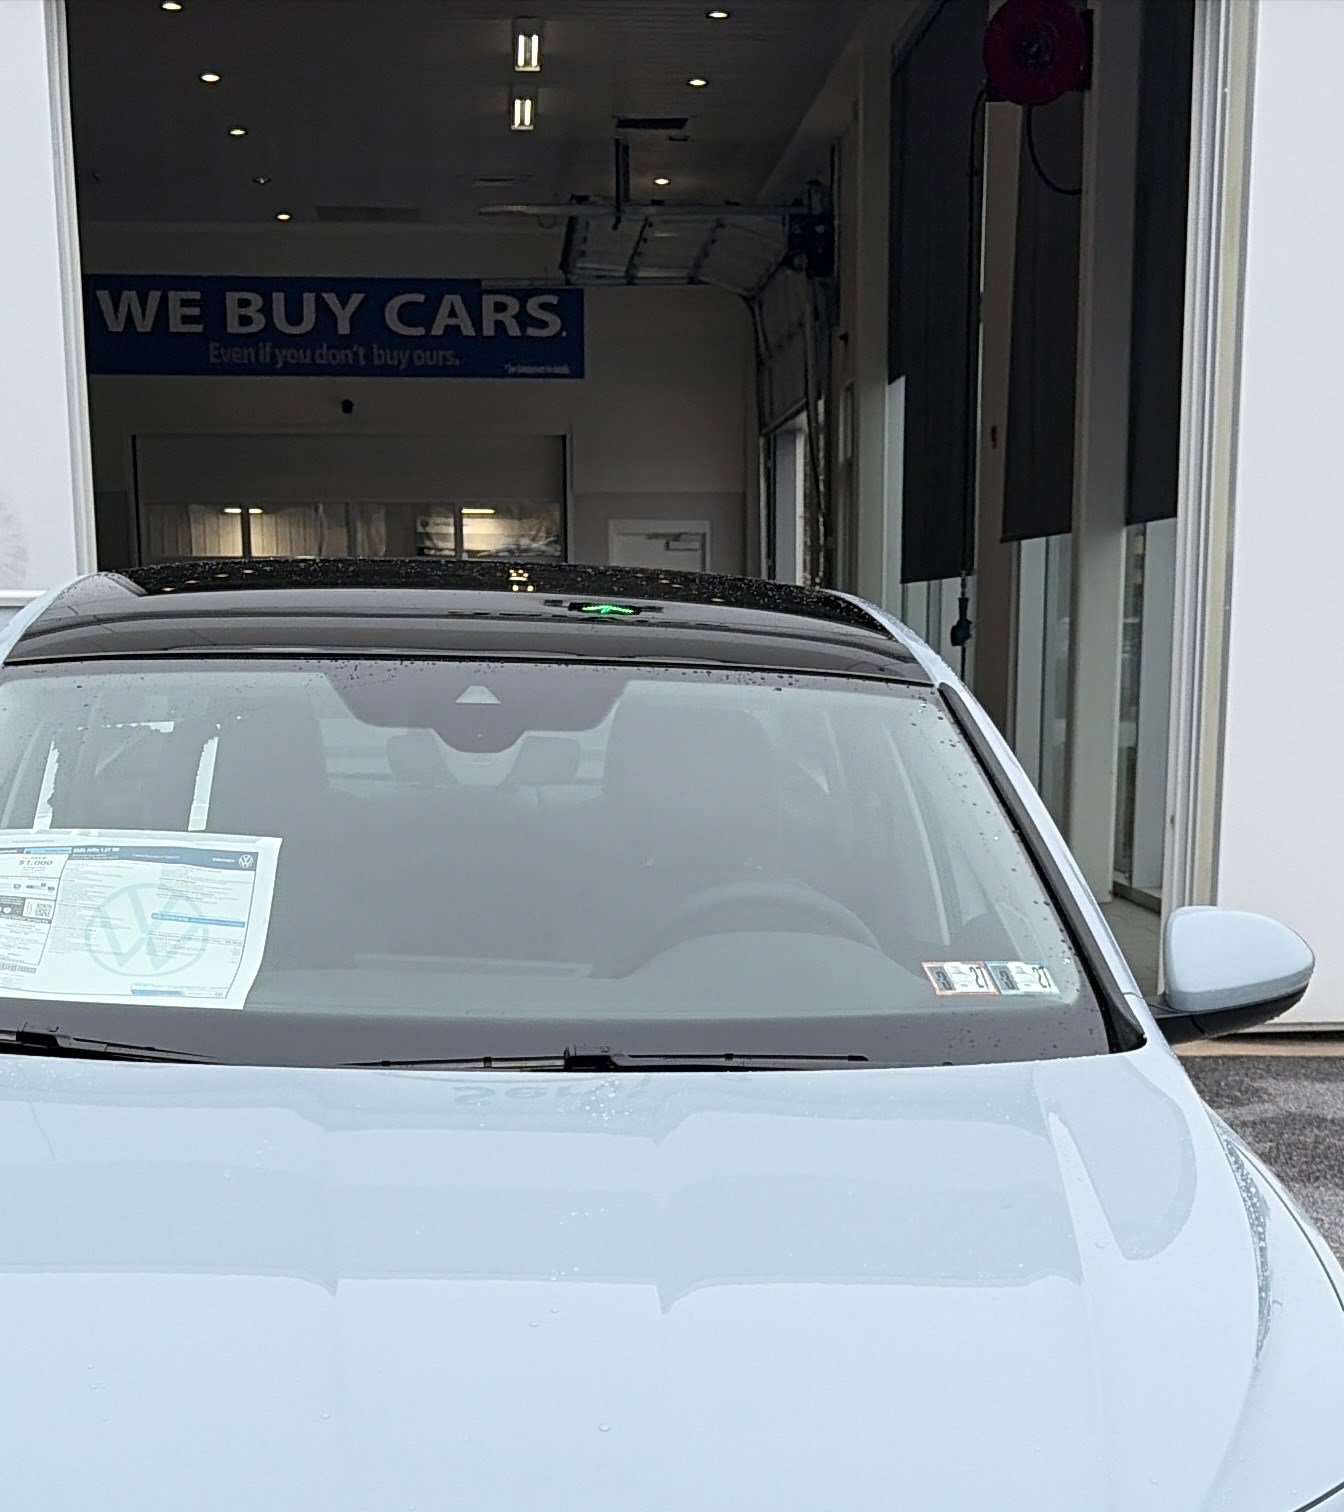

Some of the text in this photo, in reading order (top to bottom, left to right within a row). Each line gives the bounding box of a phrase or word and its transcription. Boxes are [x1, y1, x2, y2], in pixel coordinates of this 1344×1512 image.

[95, 289, 568, 339] WE BUY CARS.
[208, 342, 256, 366] Even
[257, 342, 274, 366] if
[274, 346, 313, 371] you
[372, 343, 411, 371] buy
[411, 348, 464, 368] ours.
